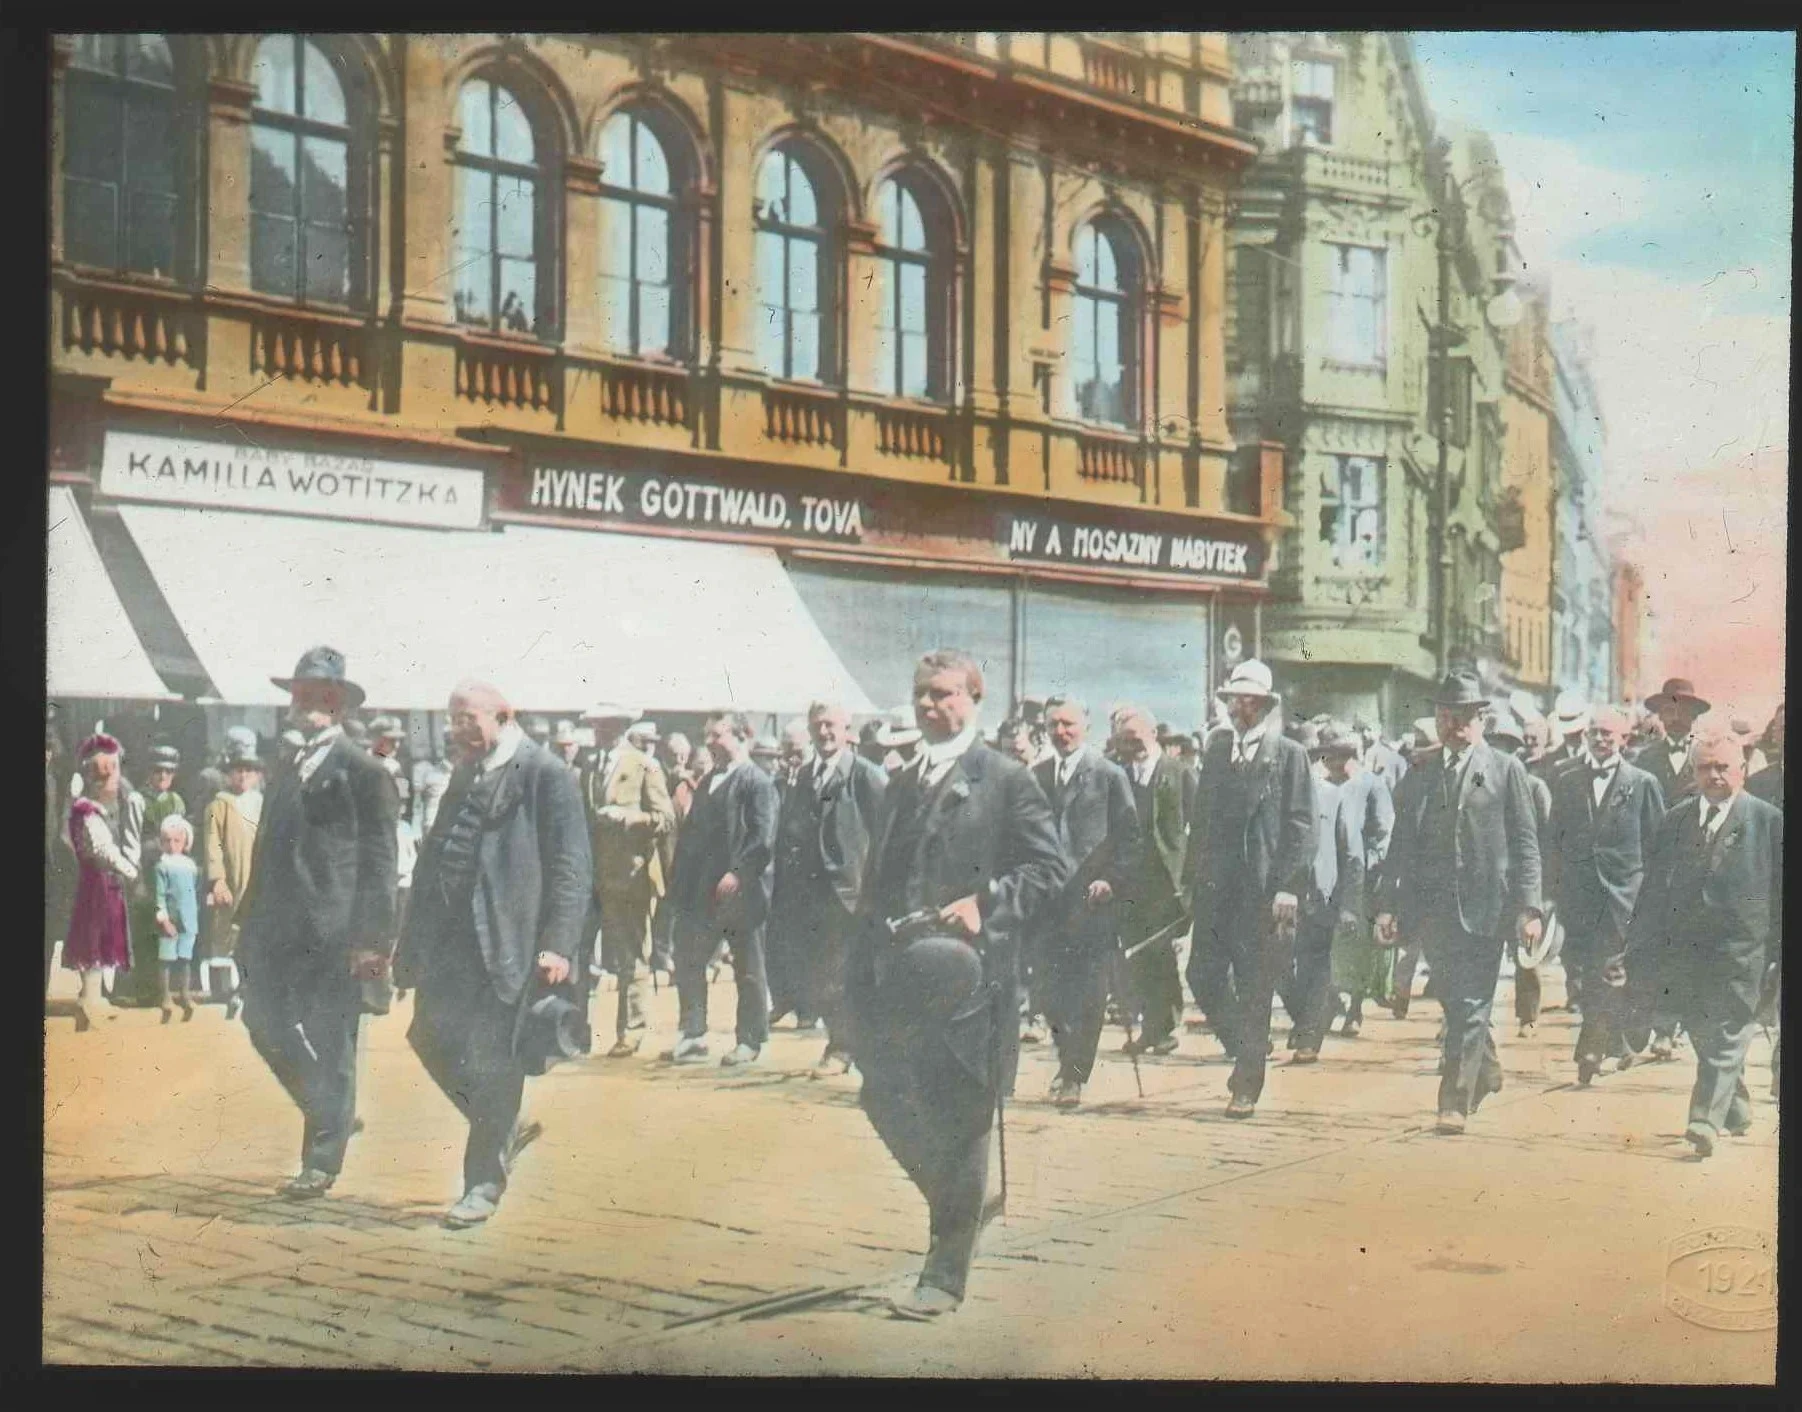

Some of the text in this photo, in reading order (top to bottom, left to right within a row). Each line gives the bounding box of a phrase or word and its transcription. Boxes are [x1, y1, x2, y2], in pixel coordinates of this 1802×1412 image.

[128, 451, 458, 505] KAMILLA WOTITZKA
[531, 468, 627, 513] HYNEK
[1045, 524, 1062, 556] A
